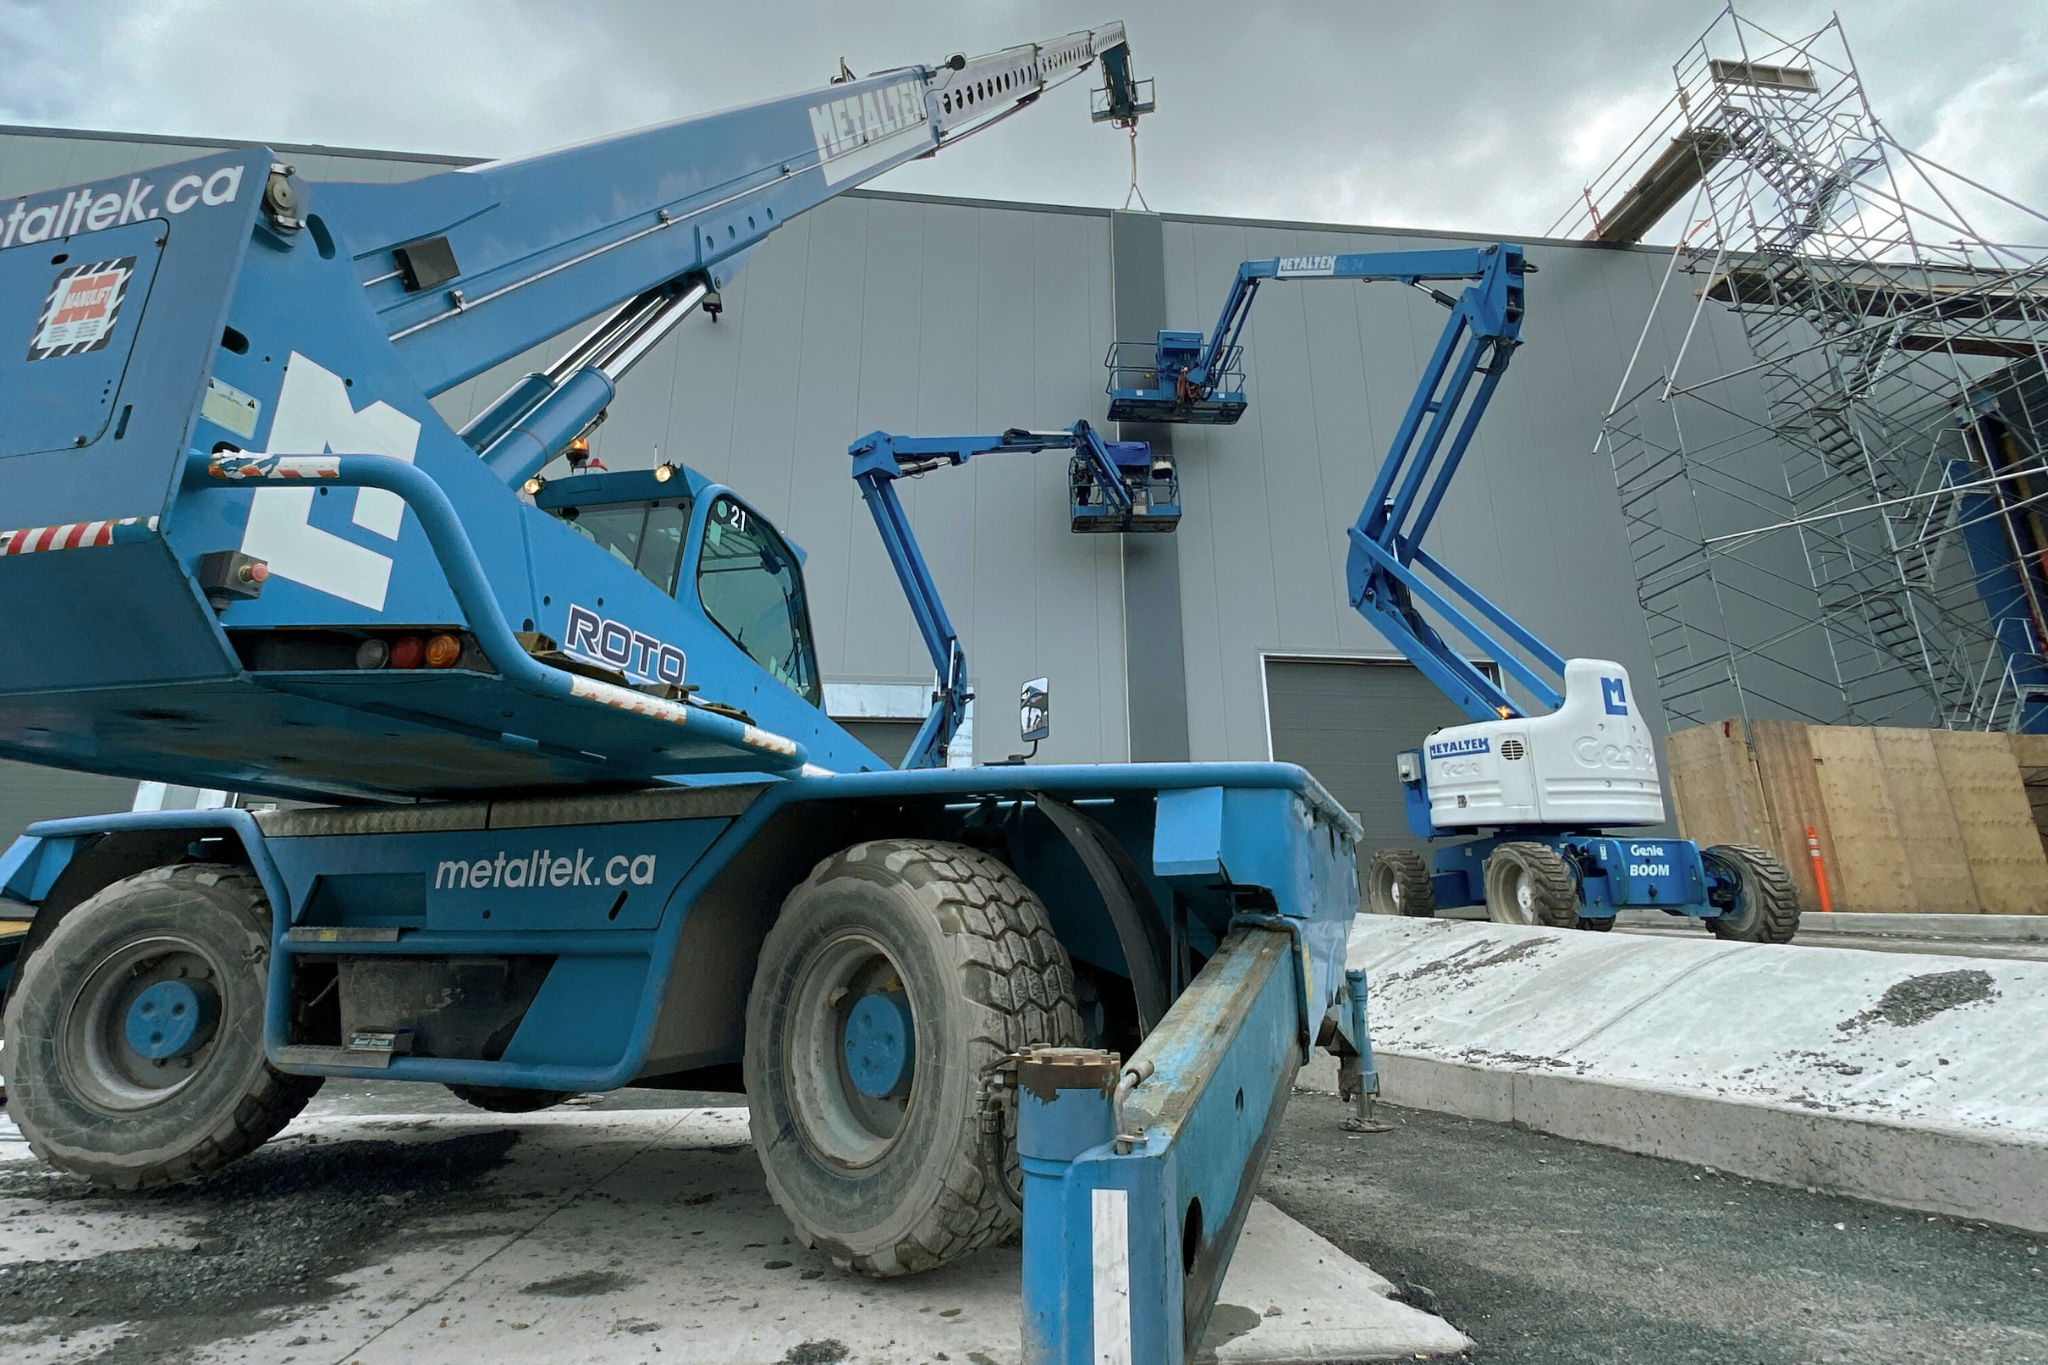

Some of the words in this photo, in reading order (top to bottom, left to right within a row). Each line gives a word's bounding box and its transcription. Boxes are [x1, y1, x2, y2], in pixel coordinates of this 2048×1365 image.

[0, 165, 245, 248] taltek.ca
[1280, 255, 1336, 271] METALTEK
[731, 505, 746, 532] 21
[565, 603, 687, 685] ROTO
[1429, 737, 1490, 758] METALTEK
[1630, 844, 1665, 856] Genie
[435, 848, 656, 889] metaltek.ca
[1629, 864, 1669, 876] BOOM
